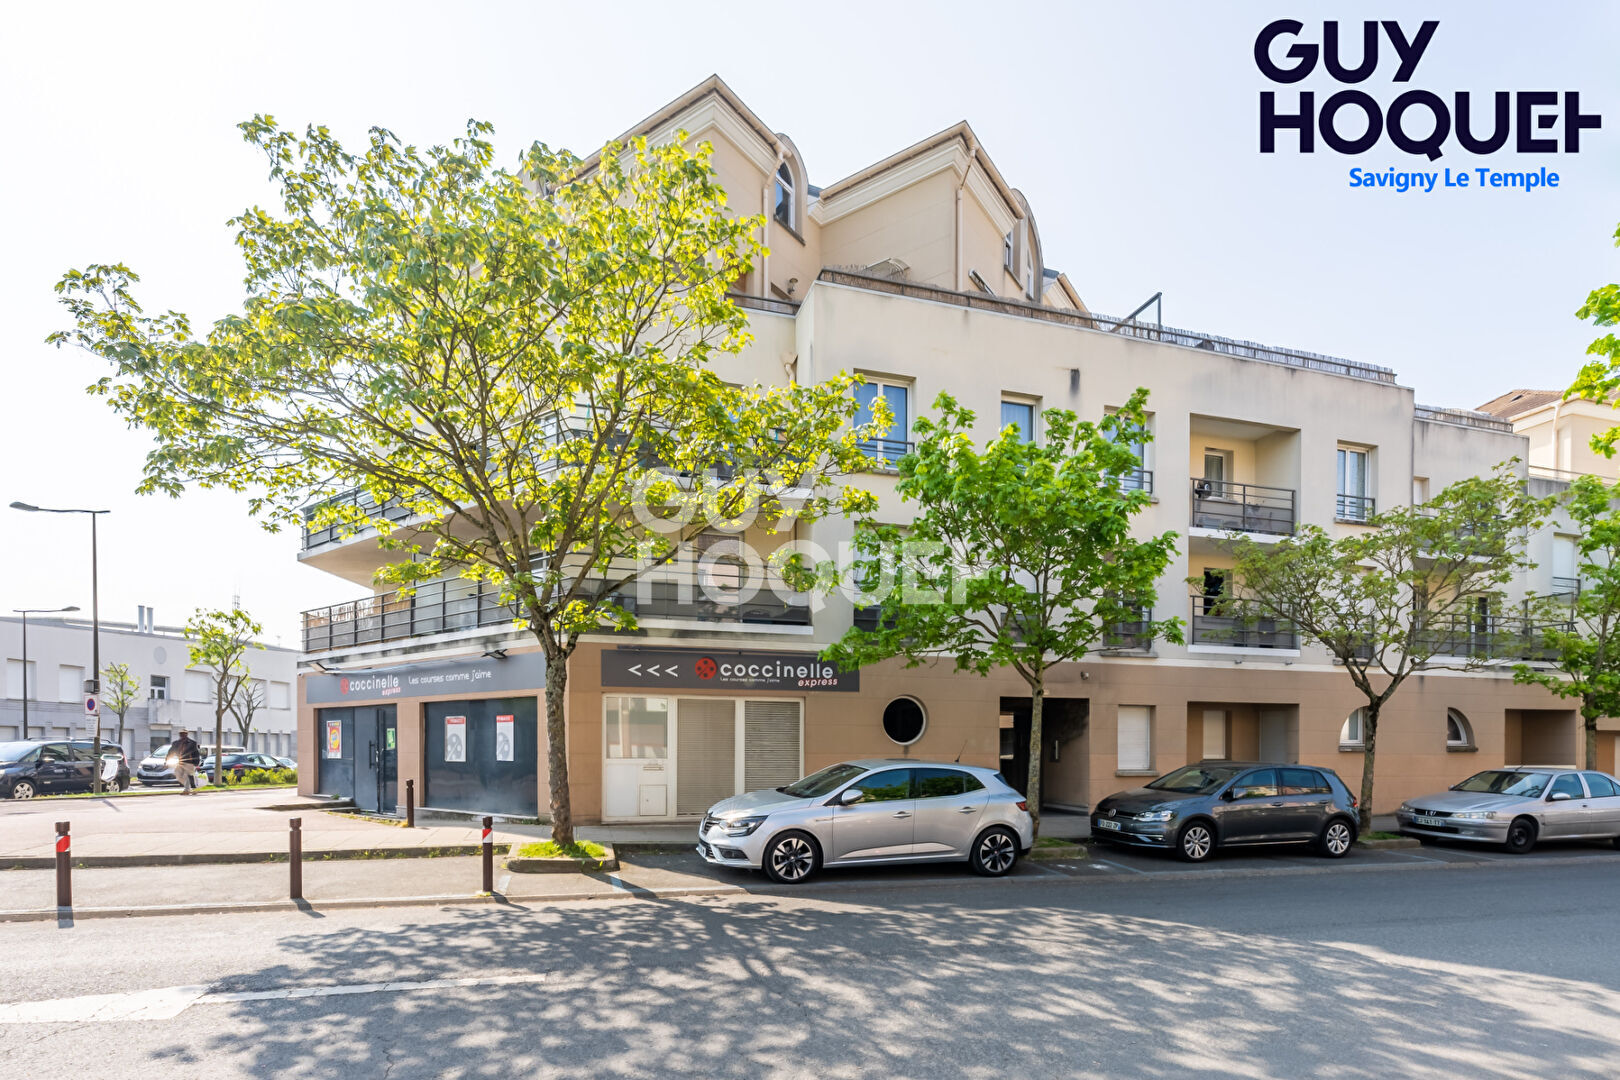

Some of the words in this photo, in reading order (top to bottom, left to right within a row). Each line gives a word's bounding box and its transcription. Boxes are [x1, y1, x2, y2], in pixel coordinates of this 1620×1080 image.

[719, 661, 834, 679] coccinelle
[350, 675, 399, 691] coccinelle
[420, 675, 444, 684] courses
[446, 673, 470, 682] comme
[797, 678, 838, 688] express
